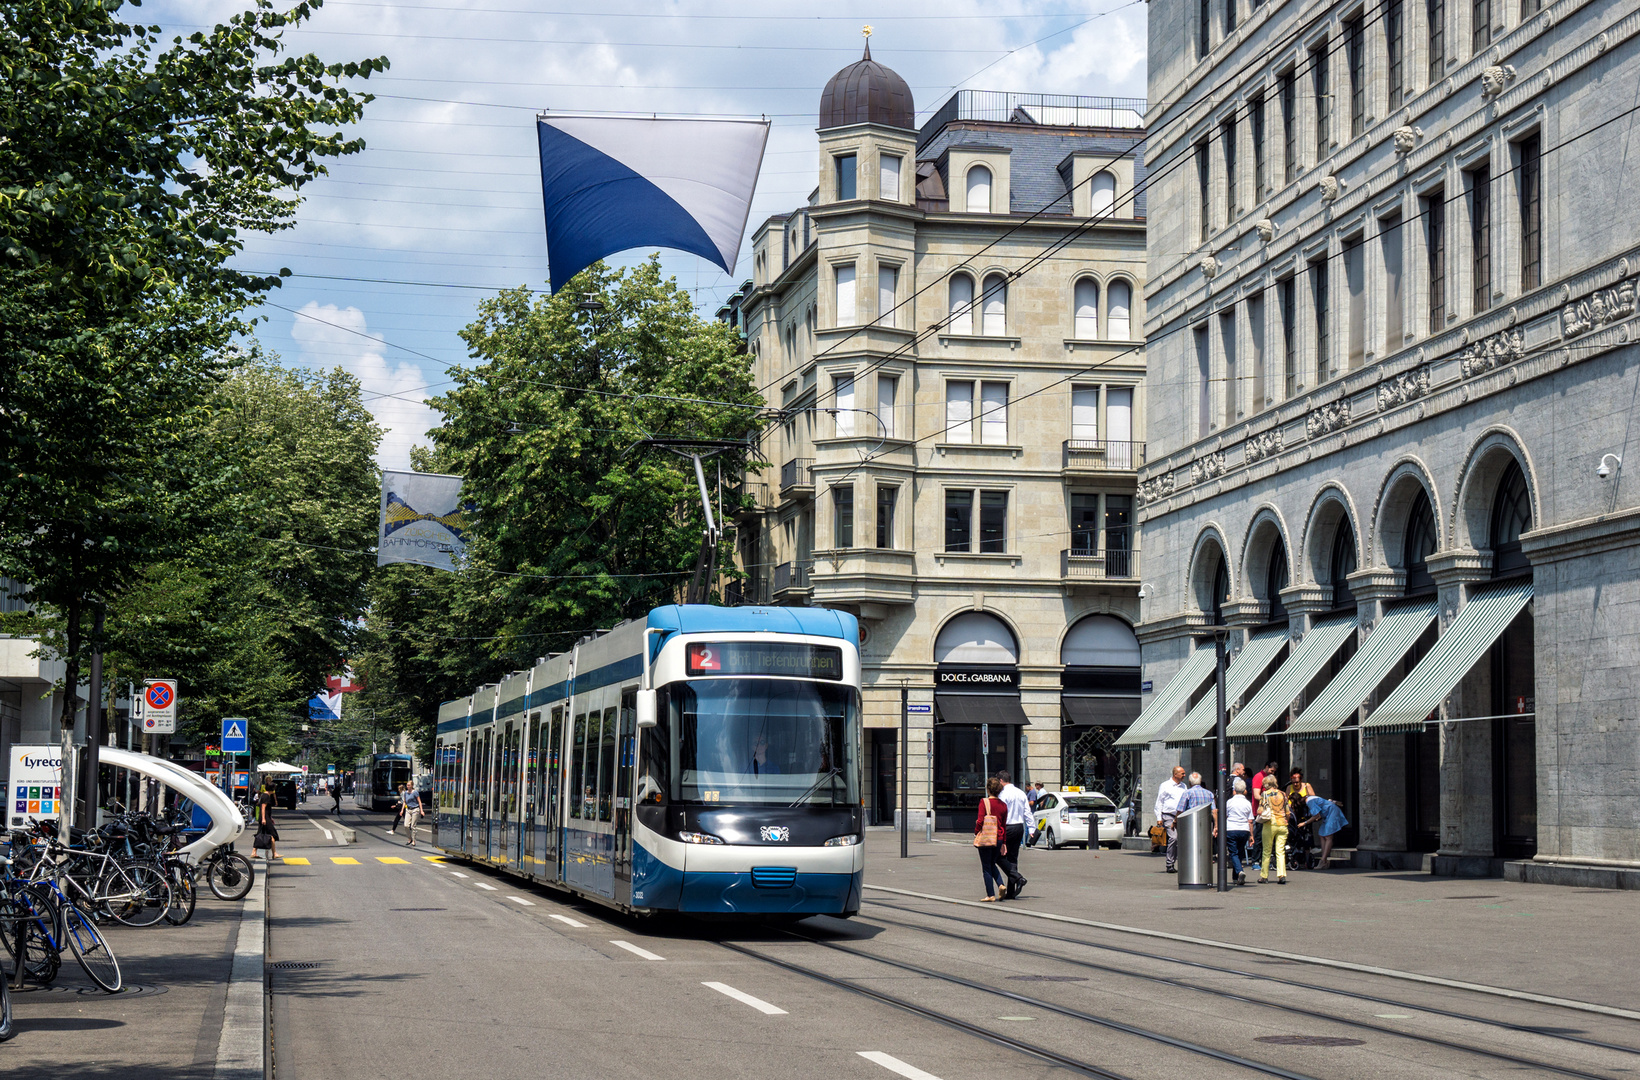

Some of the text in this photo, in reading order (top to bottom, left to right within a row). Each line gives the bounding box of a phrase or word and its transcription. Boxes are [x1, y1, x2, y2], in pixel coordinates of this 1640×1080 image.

[404, 527, 451, 543] ZÜRCHER
[700, 650, 834, 669] 2 Bhf. Tiefenbrunnen
